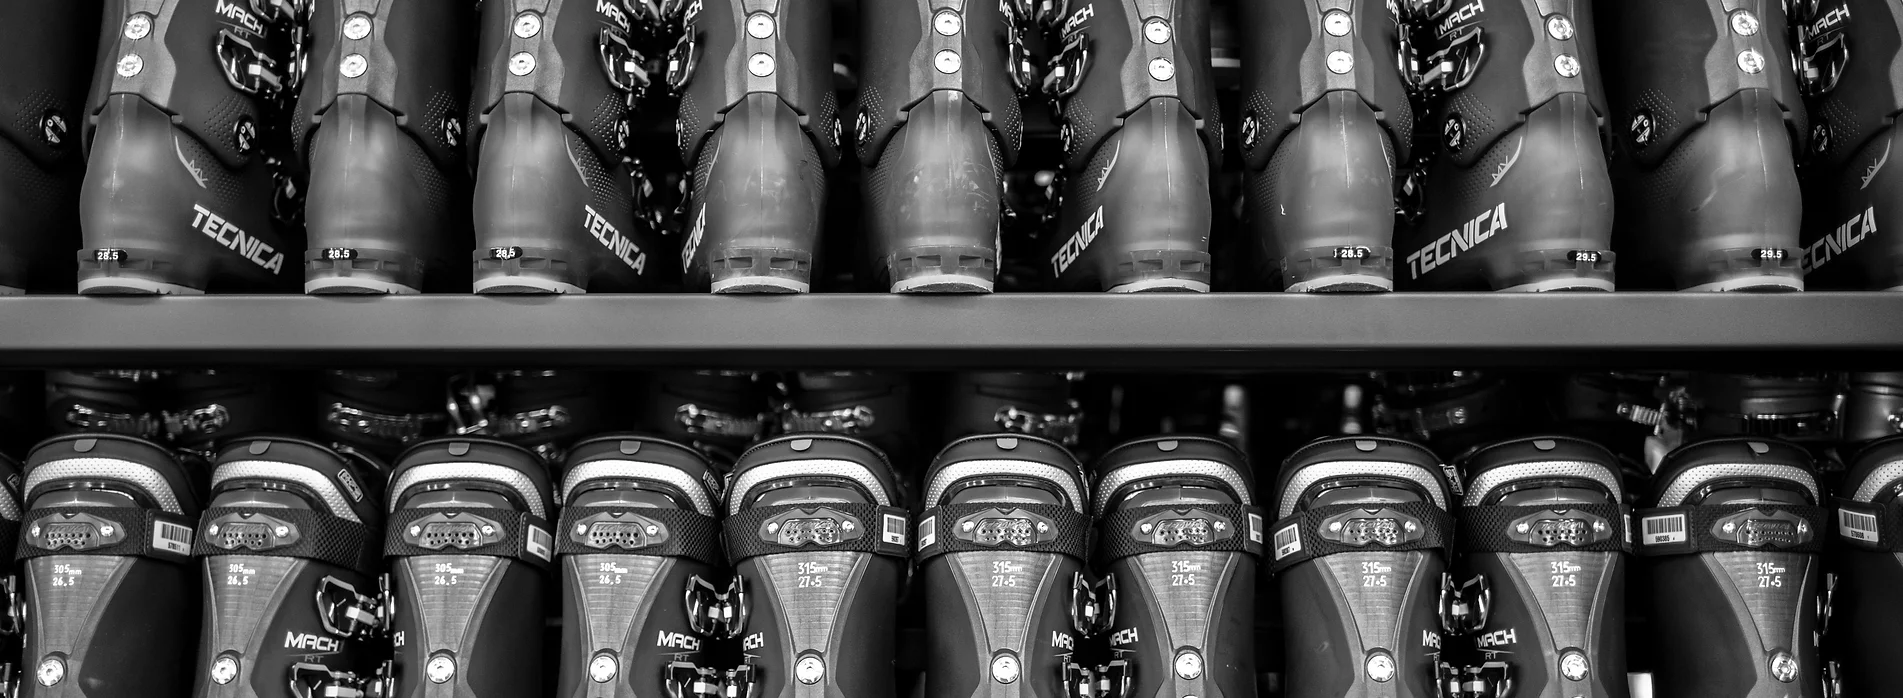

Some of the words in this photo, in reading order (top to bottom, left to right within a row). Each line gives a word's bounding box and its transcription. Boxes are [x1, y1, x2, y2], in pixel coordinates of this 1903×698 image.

[215, 0, 264, 35] MACH
[596, 0, 632, 33] MACH
[1061, 3, 1095, 38] MACH
[1439, 0, 1485, 35] MACH
[1807, 3, 1850, 40] MACH
[192, 203, 284, 275] TECNICA
[584, 204, 646, 275] TECNICA
[1051, 204, 1104, 278] TECNICA
[1406, 202, 1508, 280] TECNICA
[97, 251, 119, 260] 28.5
[329, 249, 351, 259] 28.5
[1341, 249, 1363, 258] 28.5
[1576, 252, 1597, 262] 29.5
[1760, 250, 1783, 259] 29.5
[52, 576, 75, 587] 26.5
[227, 575, 249, 586] 26.5
[434, 575, 457, 586] 26.5
[599, 574, 621, 585] 26.5
[284, 631, 339, 652] MACH
[656, 629, 701, 651] MACH
[1476, 628, 1517, 648] MACH
